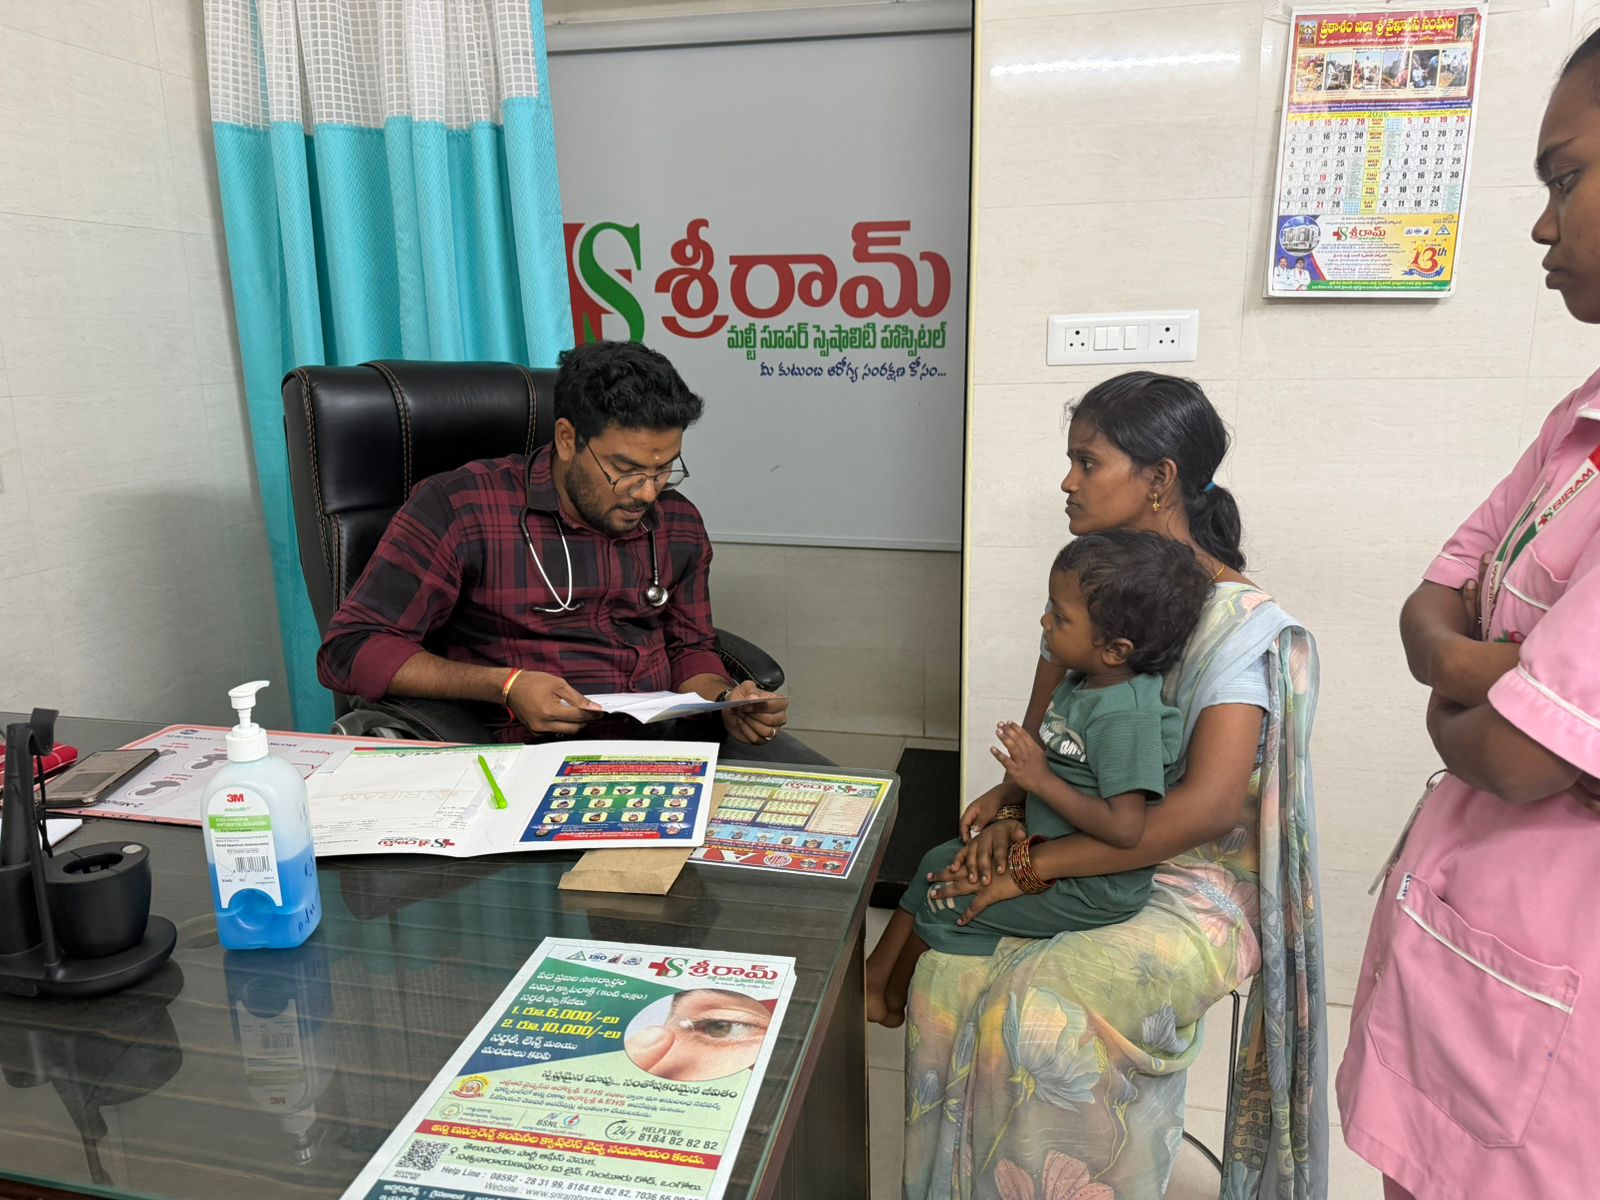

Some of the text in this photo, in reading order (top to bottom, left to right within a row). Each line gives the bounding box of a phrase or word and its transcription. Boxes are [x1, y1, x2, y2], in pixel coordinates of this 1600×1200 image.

[1349, 225, 1386, 239] శ్రీరామ్
[654, 218, 951, 339] శ్రీరామ్
[761, 323, 809, 349] సూపర్
[881, 321, 947, 357] హాస్పిటల్
[761, 362, 773, 377] మీ
[778, 362, 823, 377] కుటుంబ
[828, 357, 858, 382] ఆరోగ్య
[862, 364, 905, 382] సంరక్షణ
[227, 794, 244, 802] 3M
[689, 960, 777, 981] శ్రీరామ్
[511, 1006, 519, 1014] 1.
[501, 1019, 513, 1028] 2.
[536, 1119, 558, 1127] BSNL
[613, 1125, 683, 1140] 24/7 HELPLINE
[638, 1133, 718, 1150] 8184 82 82 82
[441, 1166, 459, 1176] Help
[460, 1169, 480, 1178] Line
[490, 1173, 518, 1184] 08592
[524, 1177, 536, 1186] 28
[567, 1182, 588, 1191] 8184
[591, 1185, 602, 1193] 82
[604, 1188, 616, 1196] 82
[635, 1191, 657, 1200] 7036
[485, 1182, 518, 1192] Website
